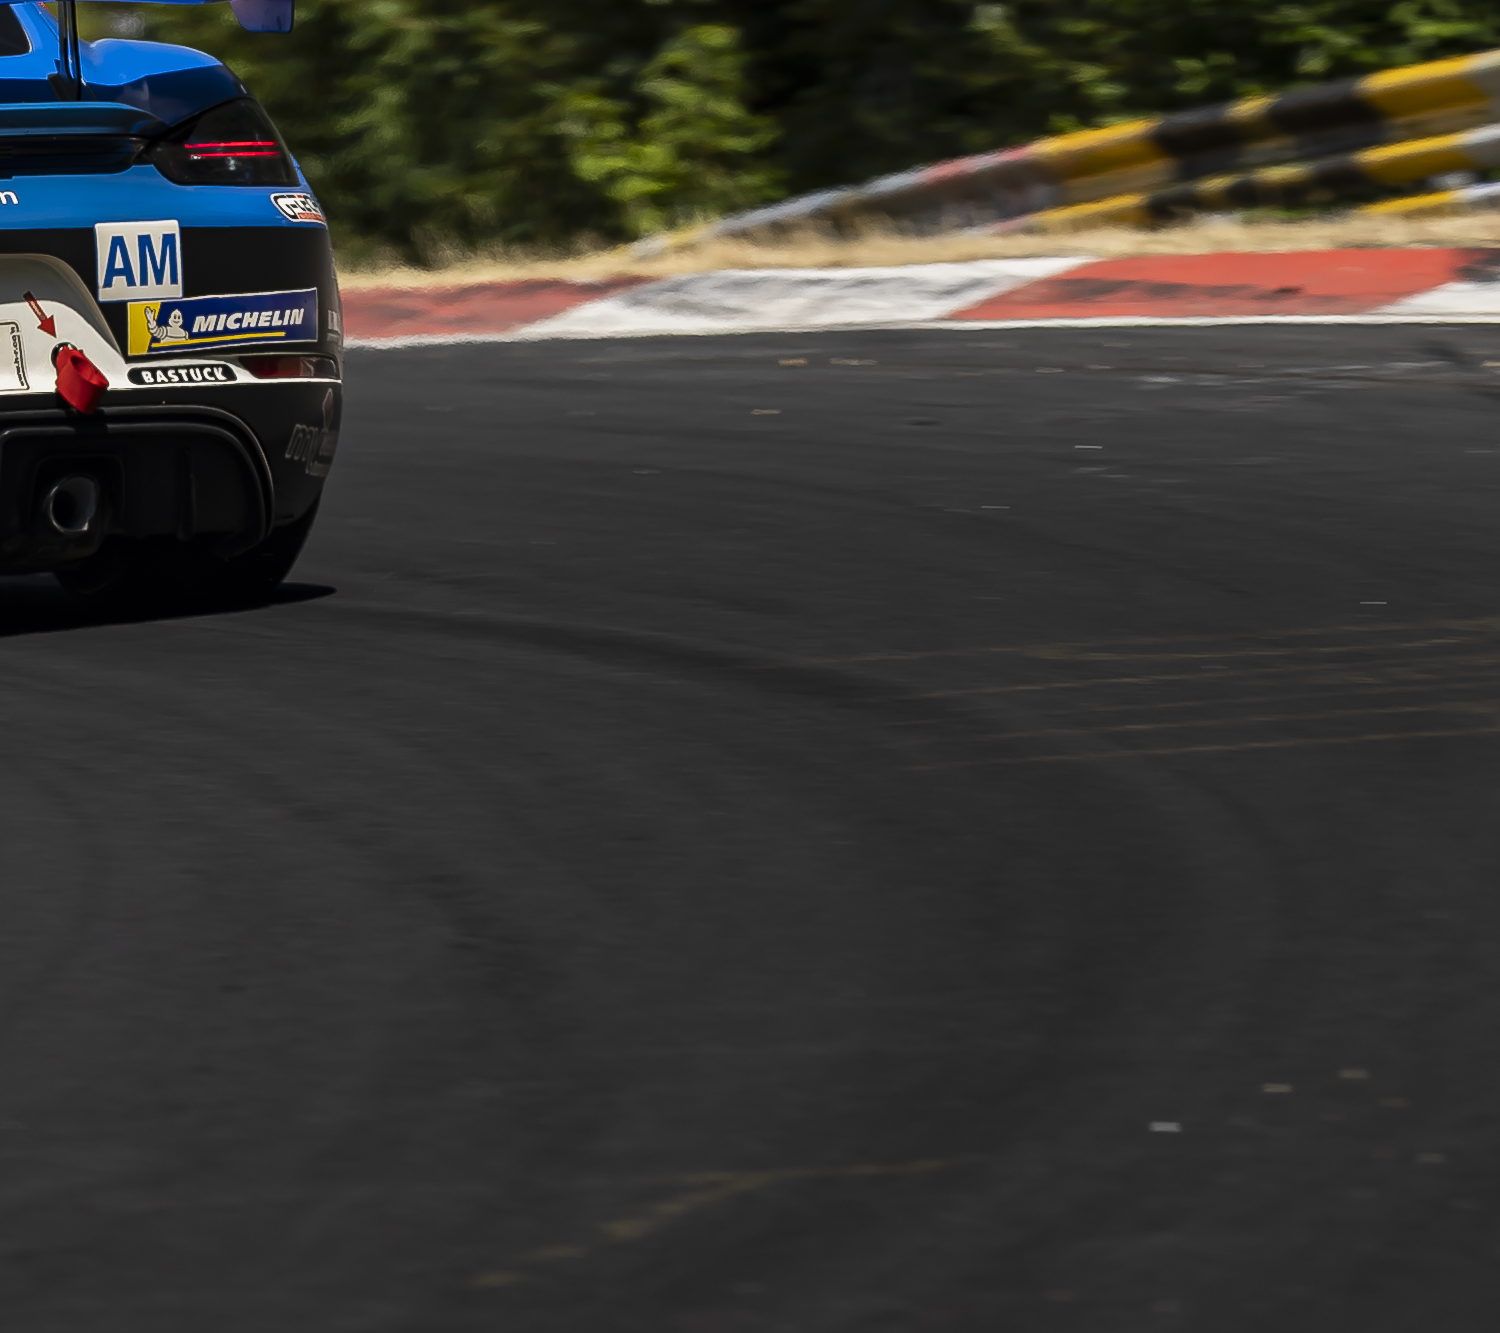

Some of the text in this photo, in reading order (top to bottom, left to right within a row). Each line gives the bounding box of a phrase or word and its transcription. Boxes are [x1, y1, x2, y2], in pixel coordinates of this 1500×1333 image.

[101, 233, 179, 288] AM
[191, 308, 305, 333] MICHELIN
[141, 367, 226, 383] BASTUCK
